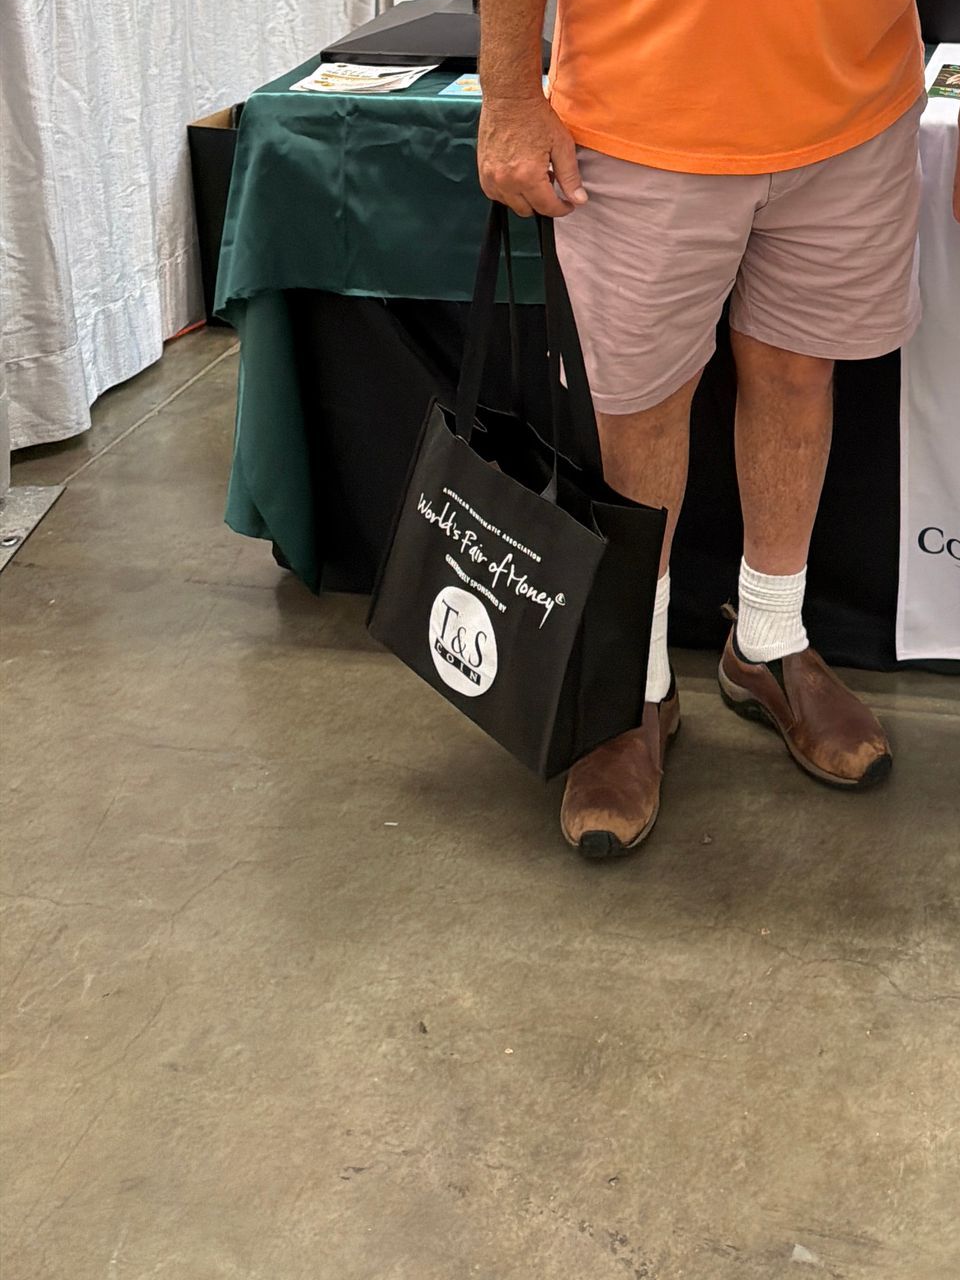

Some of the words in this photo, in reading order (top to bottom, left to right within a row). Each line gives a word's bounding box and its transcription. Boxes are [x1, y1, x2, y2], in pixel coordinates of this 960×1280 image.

[417, 492, 461, 541] World's
[460, 530, 488, 564] Fair
[489, 553, 513, 588] of
[436, 641, 480, 684] COIN
